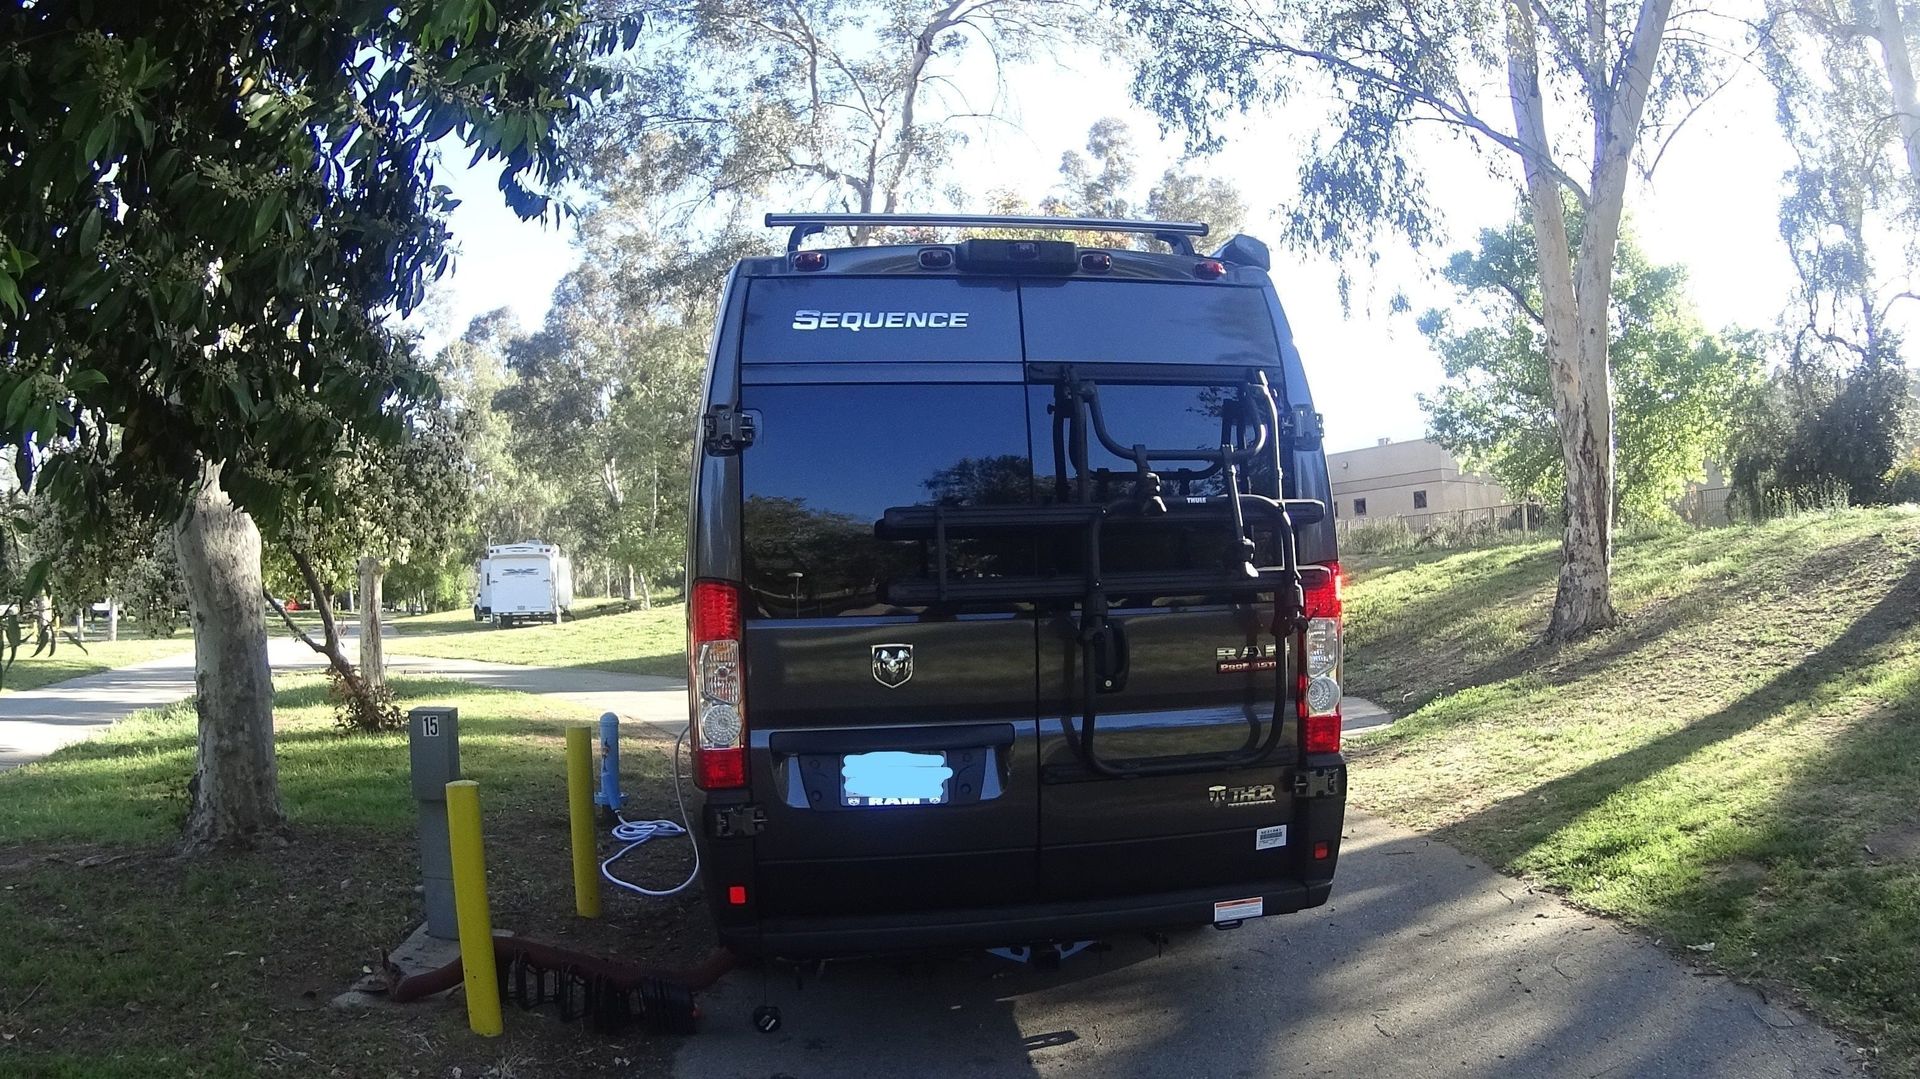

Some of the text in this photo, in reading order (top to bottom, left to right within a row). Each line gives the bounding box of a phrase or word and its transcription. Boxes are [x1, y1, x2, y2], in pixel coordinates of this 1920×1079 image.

[792, 310, 969, 331] SEQUENCE
[423, 716, 438, 735] 15
[868, 797, 920, 805] RAM
[1228, 784, 1275, 801] THOR
